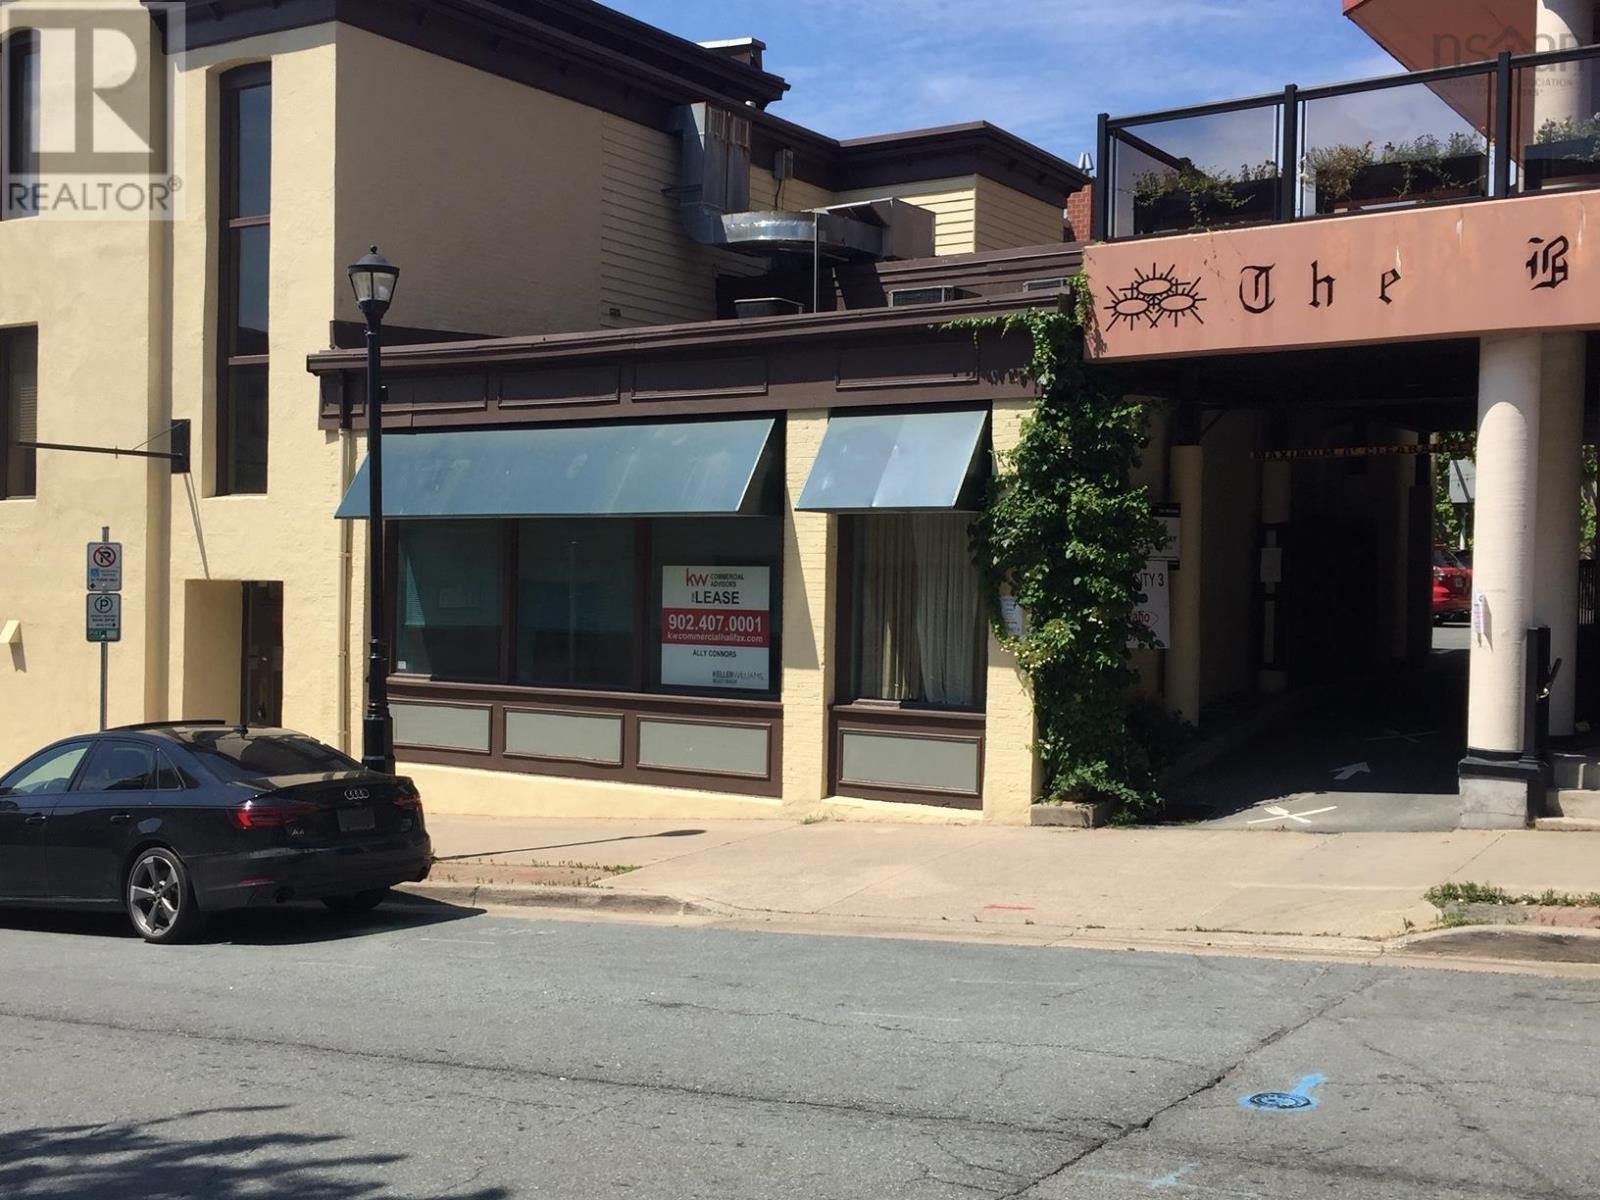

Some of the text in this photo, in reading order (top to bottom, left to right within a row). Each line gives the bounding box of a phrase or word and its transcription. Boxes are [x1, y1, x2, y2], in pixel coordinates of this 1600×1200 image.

[1239, 259, 1402, 314] The
[686, 568, 709, 586] kw
[695, 590, 740, 605] LEASE
[668, 614, 761, 632] 902.407.0001
[667, 631, 763, 642] kwcommercialhalifax.com
